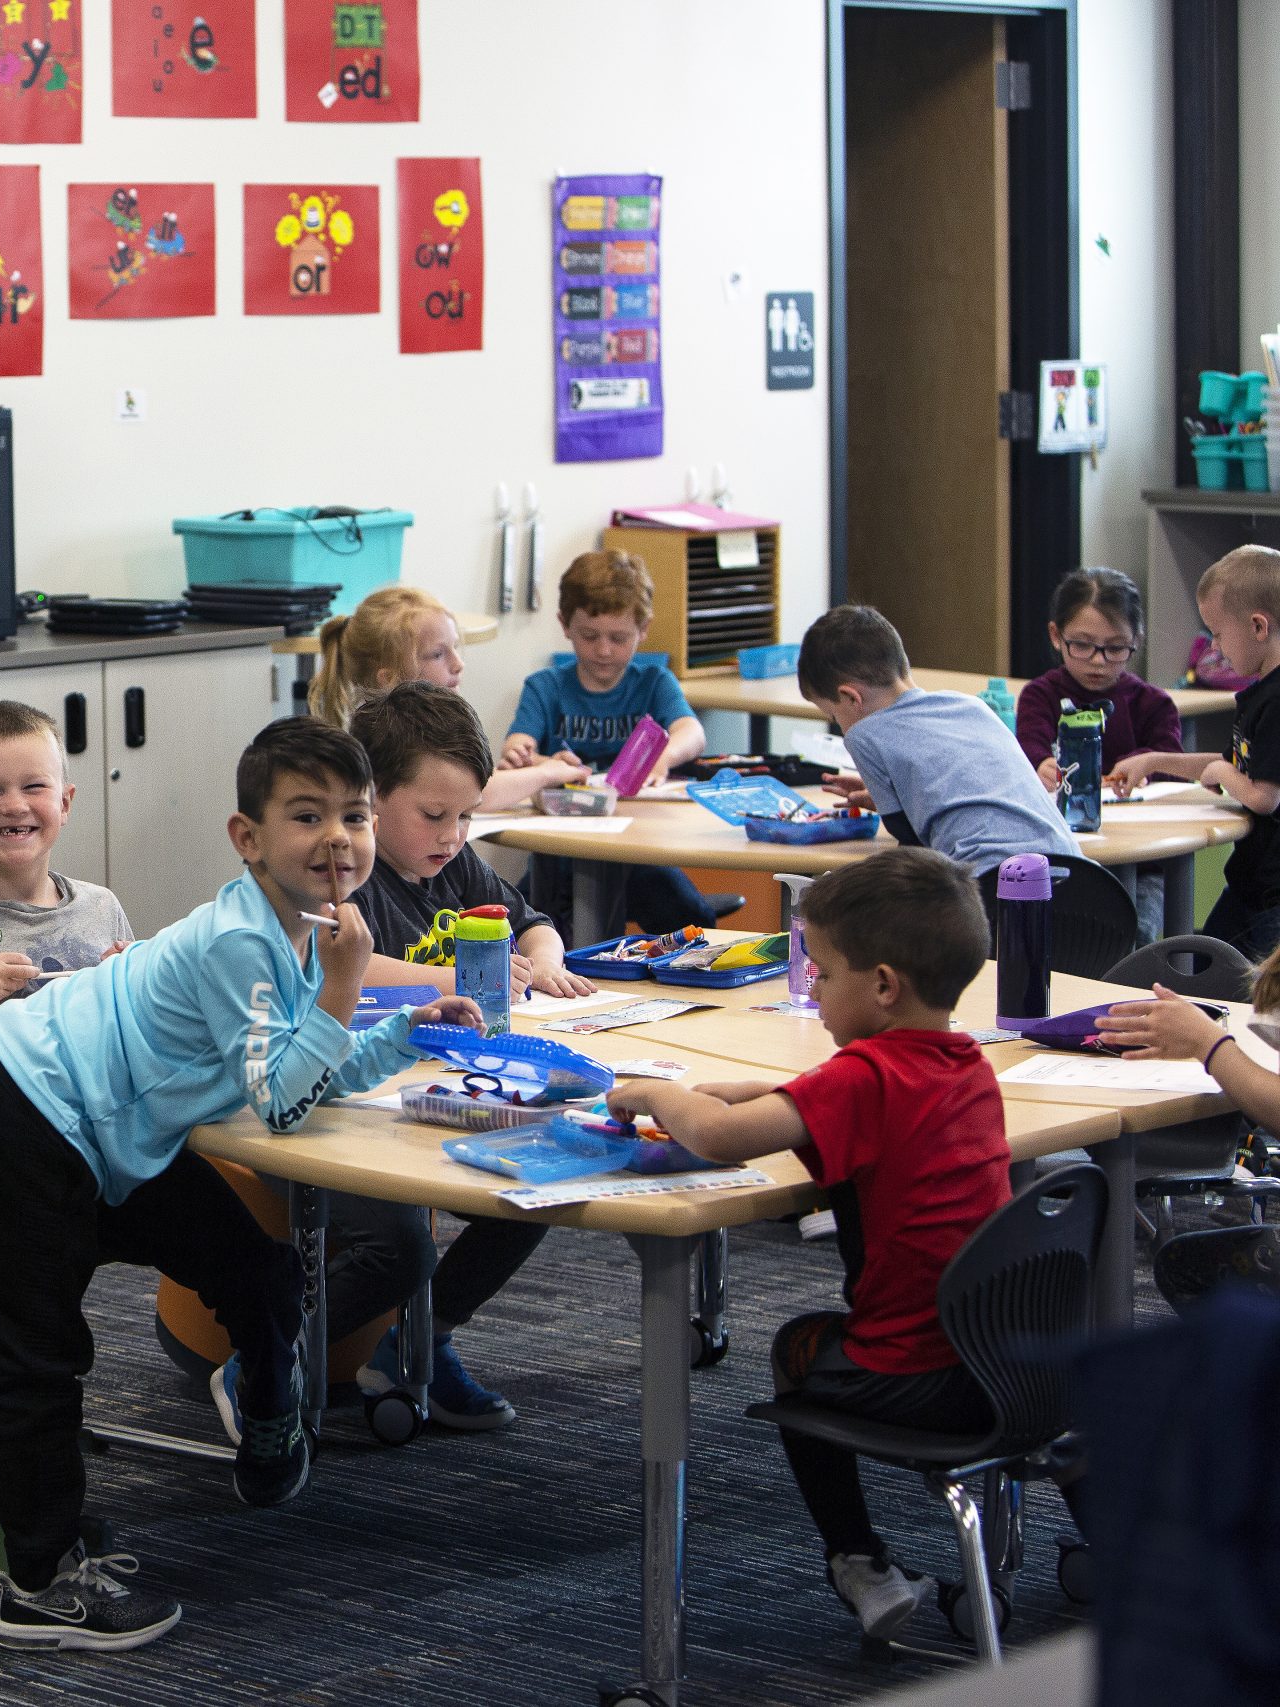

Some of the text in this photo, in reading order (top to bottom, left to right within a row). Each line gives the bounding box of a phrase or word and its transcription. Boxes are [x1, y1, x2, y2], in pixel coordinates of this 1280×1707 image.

[21, 41, 51, 89] y
[189, 22, 215, 73] e
[338, 54, 382, 100] ed
[292, 263, 327, 293] or
